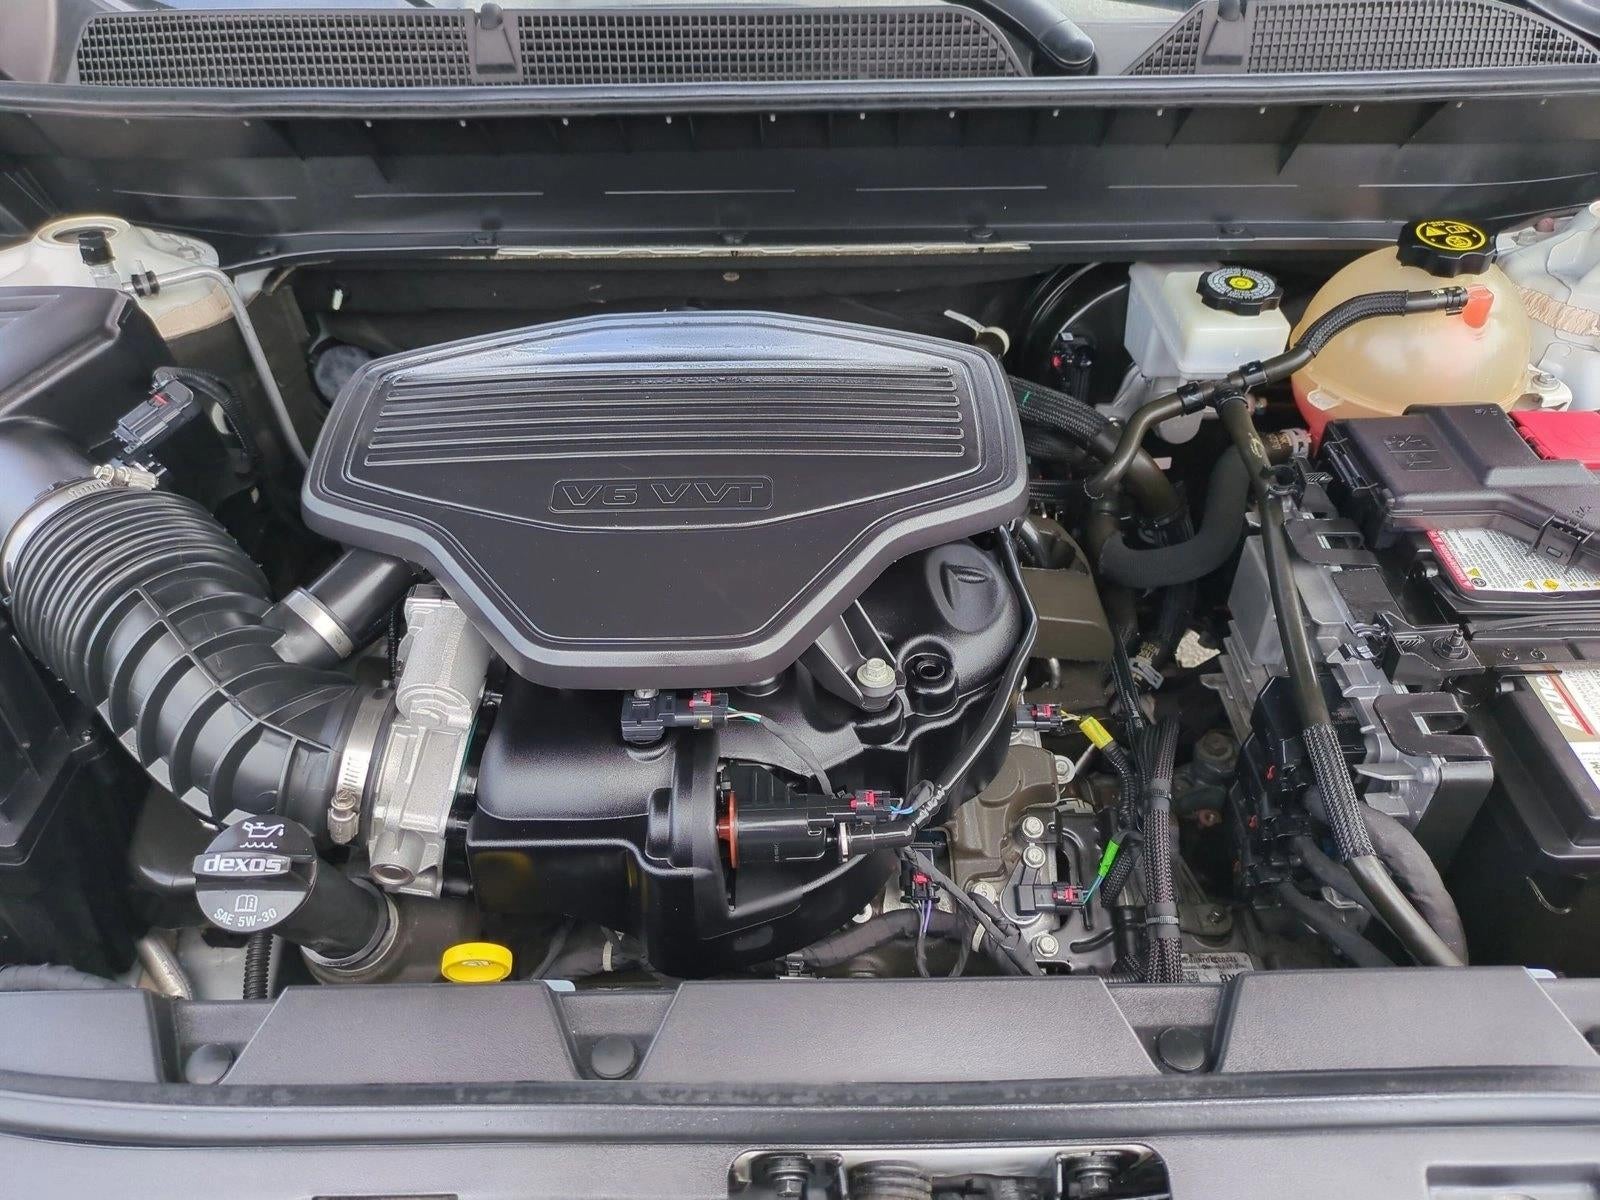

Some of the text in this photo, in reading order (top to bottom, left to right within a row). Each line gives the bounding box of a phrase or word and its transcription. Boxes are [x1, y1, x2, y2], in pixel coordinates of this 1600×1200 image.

[561, 482, 764, 506] V6 VVT
[203, 854, 282, 873] dexos
[214, 908, 277, 927] SAE 5W-30
